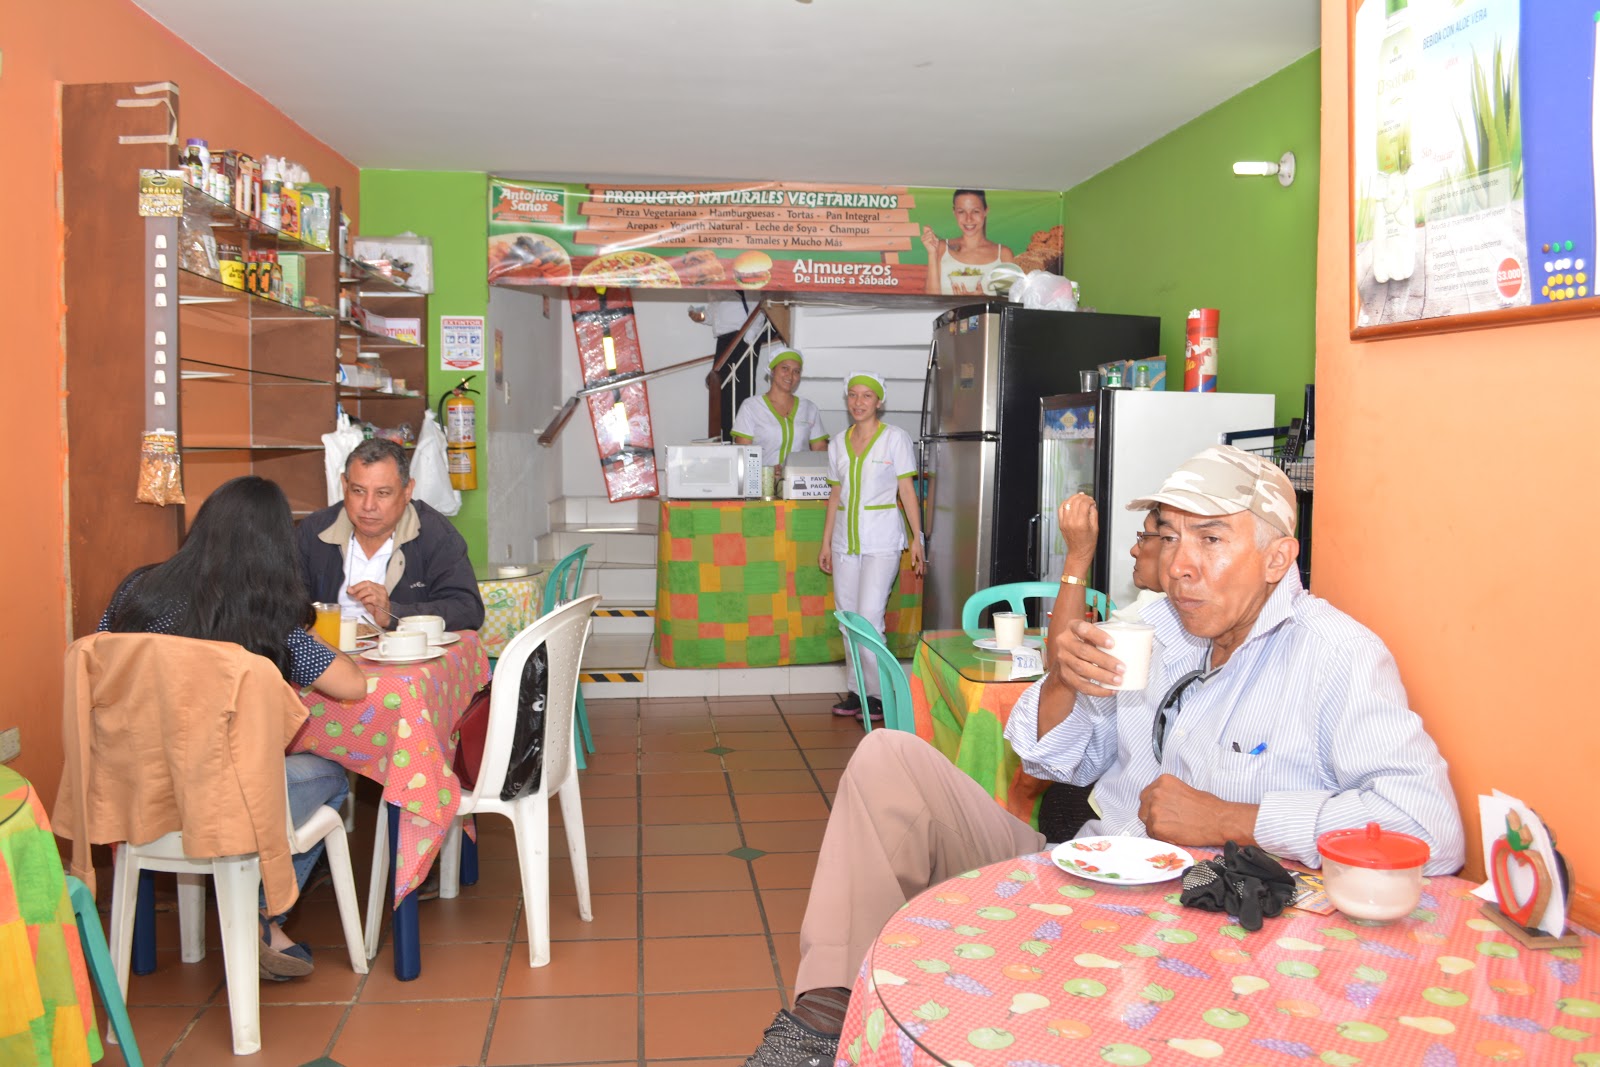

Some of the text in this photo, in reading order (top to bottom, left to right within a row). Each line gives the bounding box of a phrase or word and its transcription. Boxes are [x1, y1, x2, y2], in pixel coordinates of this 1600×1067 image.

[1423, 8, 1487, 50] BEBIDA CON ALOE VERA
[500, 188, 559, 204] Antojitos
[603, 189, 898, 209] PRODUCTOS NATURALES VEGETARIANOS
[510, 201, 548, 212] Sanos
[616, 208, 880, 222] Pizza Vegetariana Hamburguesas Tortas Pan Integral
[626, 221, 870, 236] Arepas Yogurth Natural Leche de Soya Champus
[656, 234, 843, 247] Avena Lasagna Tamales y Mucho Más
[792, 259, 892, 276] Almuerzos
[794, 274, 811, 284] De
[814, 274, 845, 285] Lunes
[858, 274, 899, 286] Sábado
[1497, 269, 1521, 281] $3.000
[386, 327, 417, 336] OTIQUÍN
